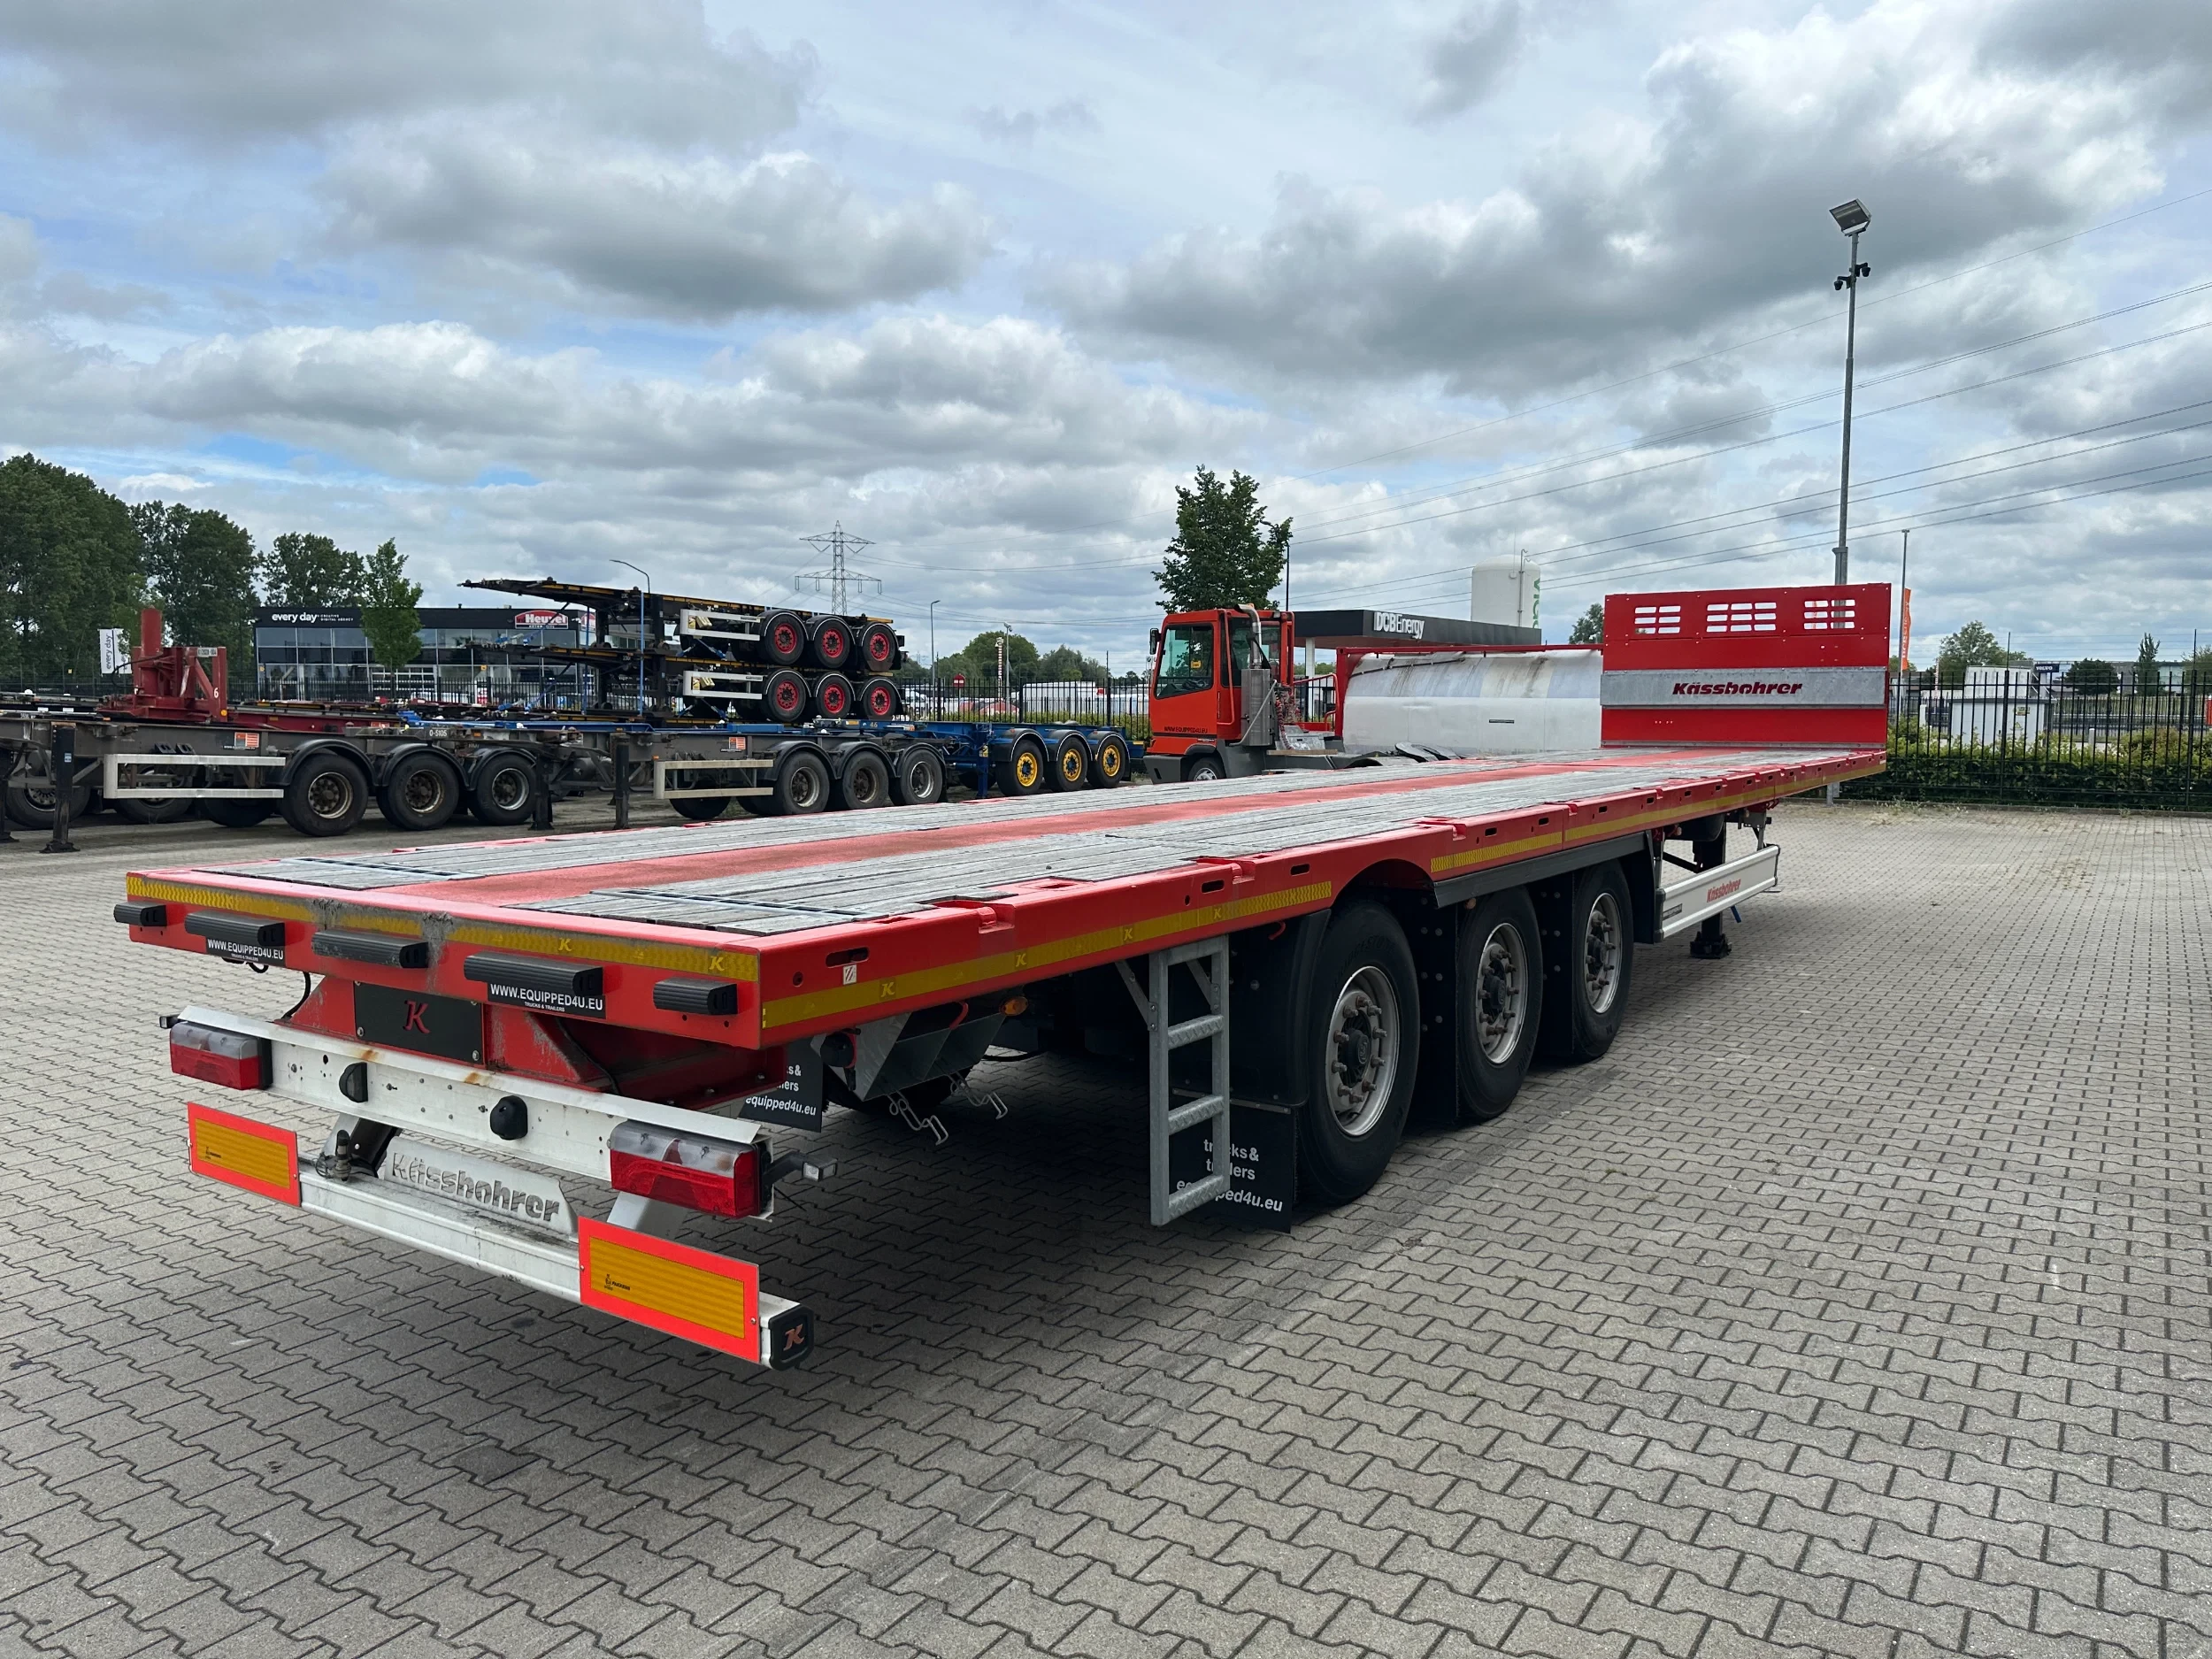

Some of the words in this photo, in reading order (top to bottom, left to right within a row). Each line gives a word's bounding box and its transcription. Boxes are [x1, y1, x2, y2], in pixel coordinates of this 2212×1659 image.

[272, 613, 298, 623] every
[299, 612, 318, 623] day
[104, 634, 113, 649] day
[213, 687, 219, 698] 6
[1672, 681, 1802, 695] Kässbohrer
[1707, 878, 1741, 902] Kässbohrer
[207, 938, 284, 960] WWW.EQUIPPED4U.EU
[709, 956, 726, 972] K
[490, 983, 603, 1010] WWW.EQUIPPED4U.EU
[403, 1000, 431, 1033] K
[745, 1095, 817, 1116] equipped4u.eu
[1203, 1139, 1248, 1159] trks
[1248, 1147, 1259, 1162] &
[1205, 1158, 1256, 1180] tlers
[391, 1151, 561, 1222] Kässbohrer
[1176, 1179, 1283, 1212] eed4u.eu
[783, 1324, 805, 1351] K
